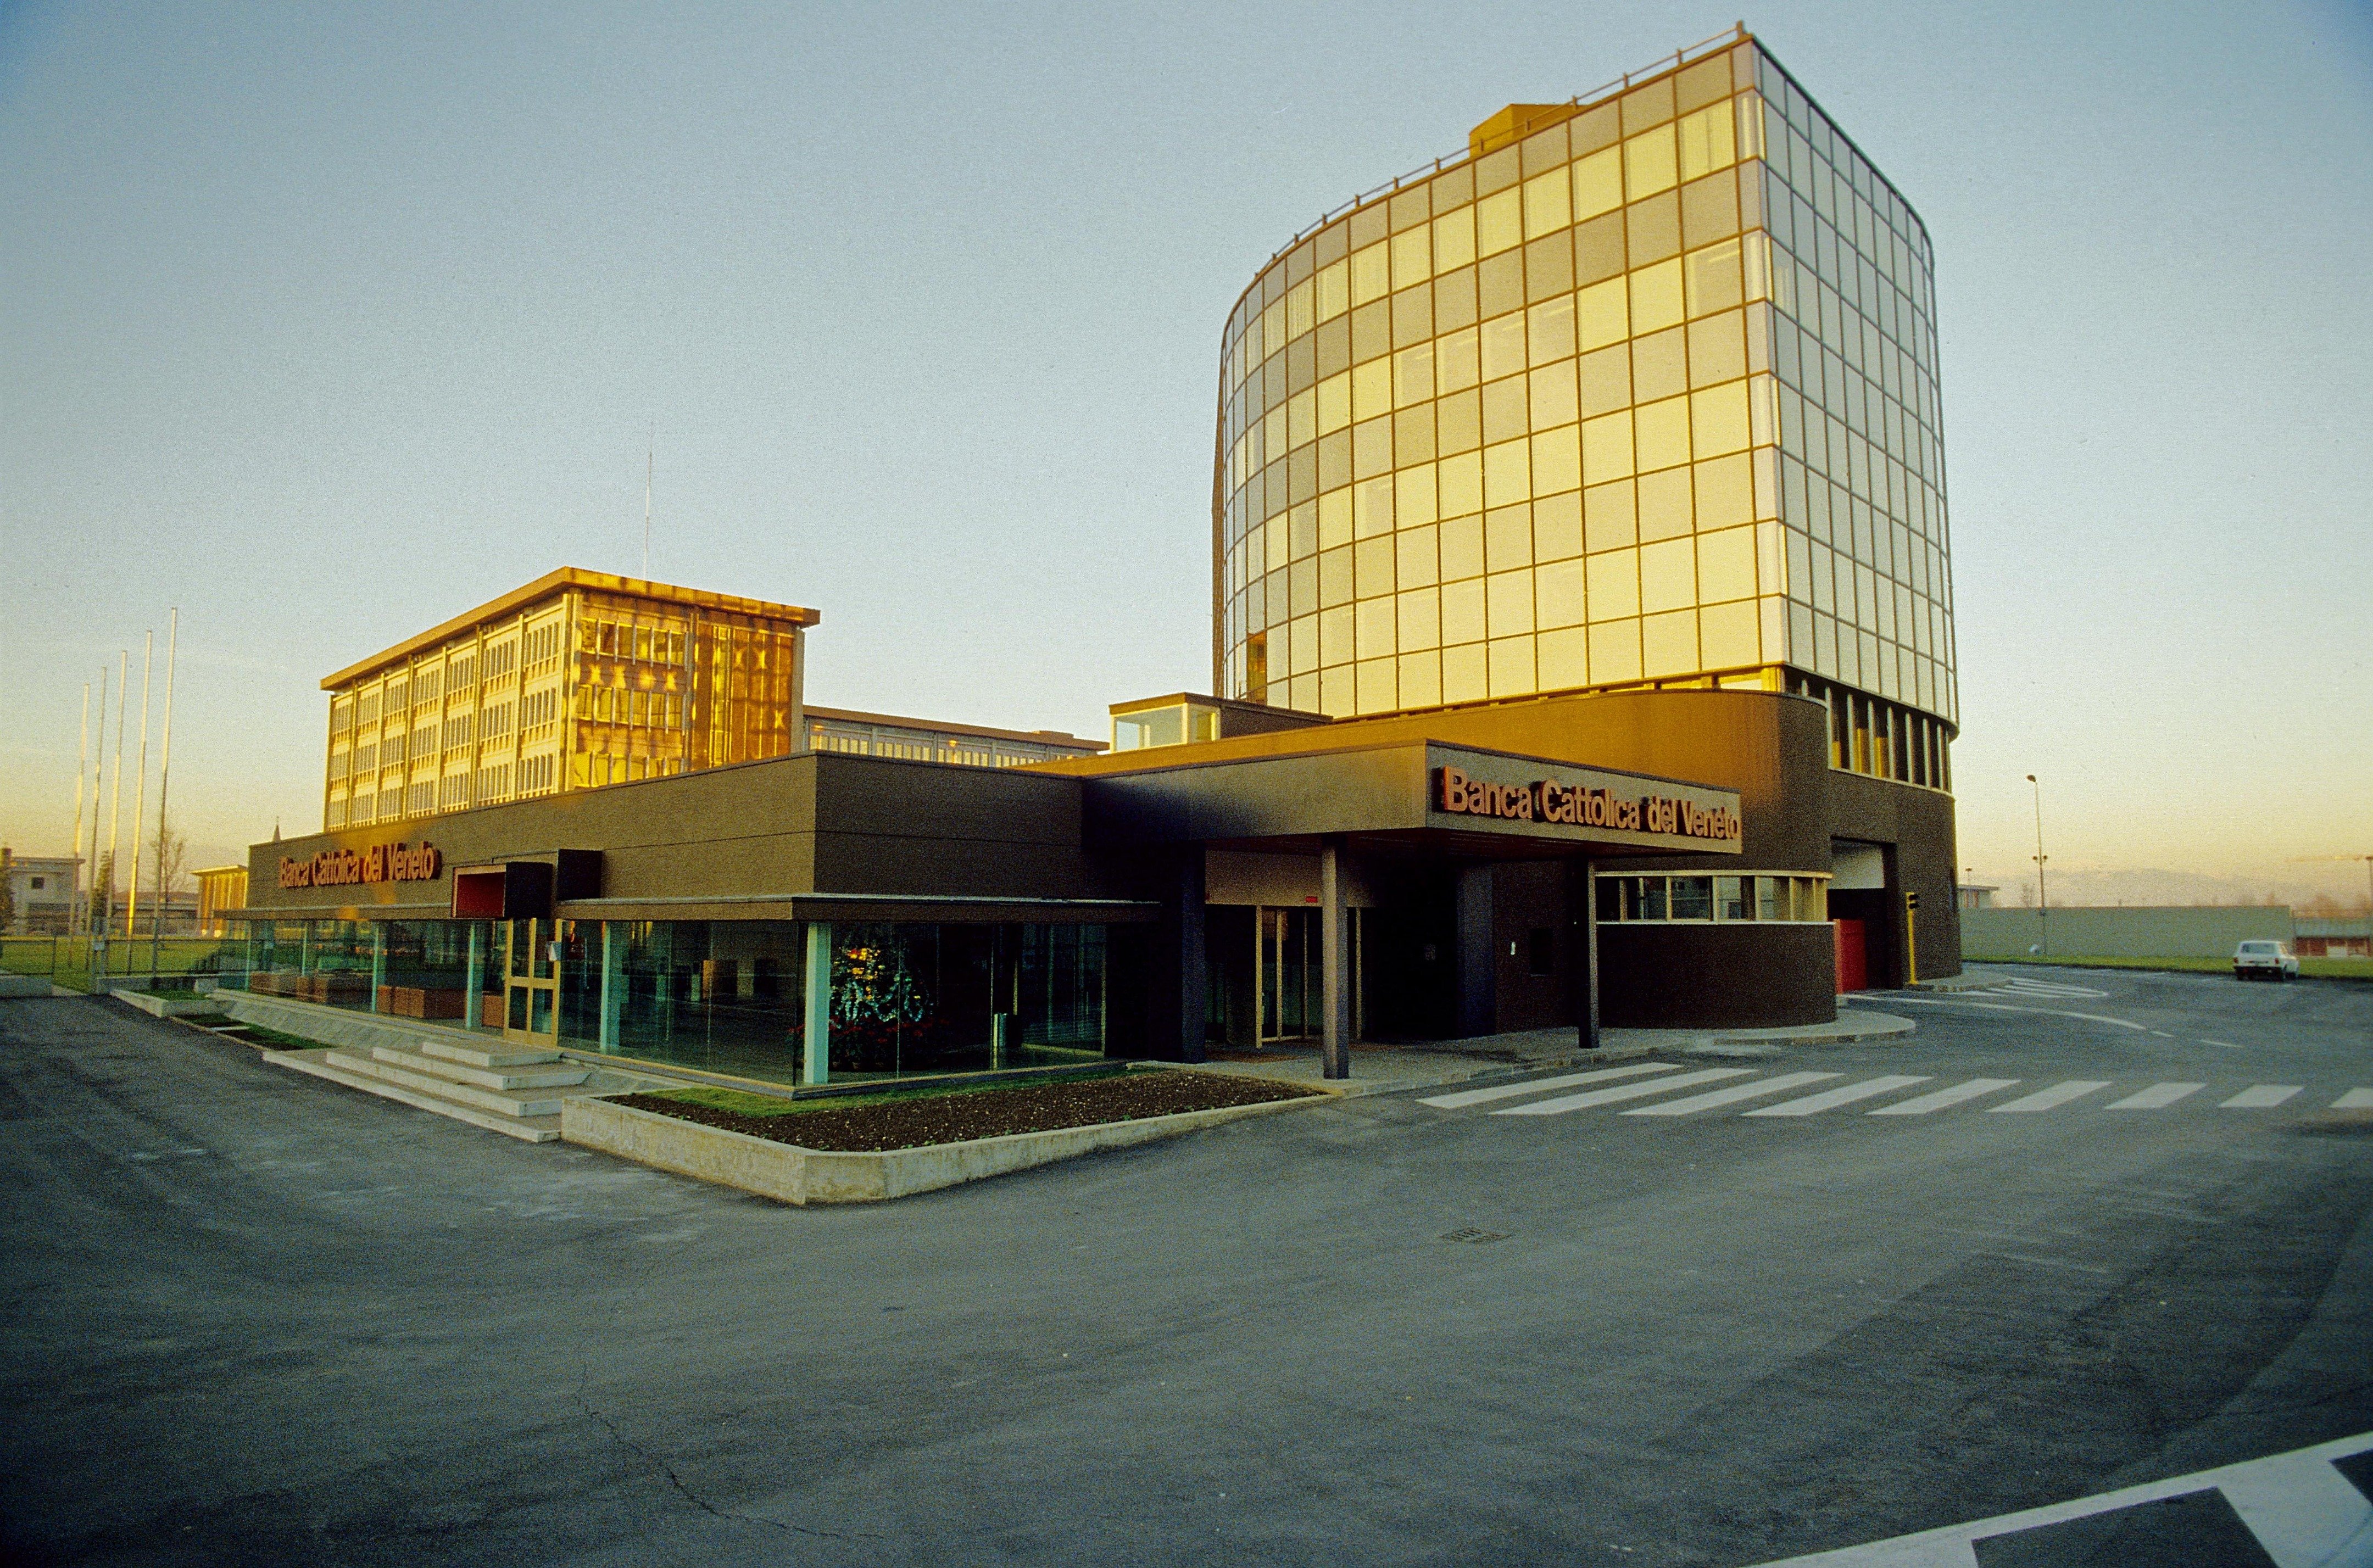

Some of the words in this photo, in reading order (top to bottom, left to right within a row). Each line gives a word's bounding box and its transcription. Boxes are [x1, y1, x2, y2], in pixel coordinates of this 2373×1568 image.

[1443, 766, 1532, 819] Banca
[1542, 779, 1641, 830] Cattolica
[1648, 796, 1677, 834] del
[1682, 800, 1739, 840] Veneto
[279, 857, 309, 888] Banca
[313, 849, 359, 886] Cattolica
[364, 845, 383, 883] del
[387, 841, 434, 880] Veneto
